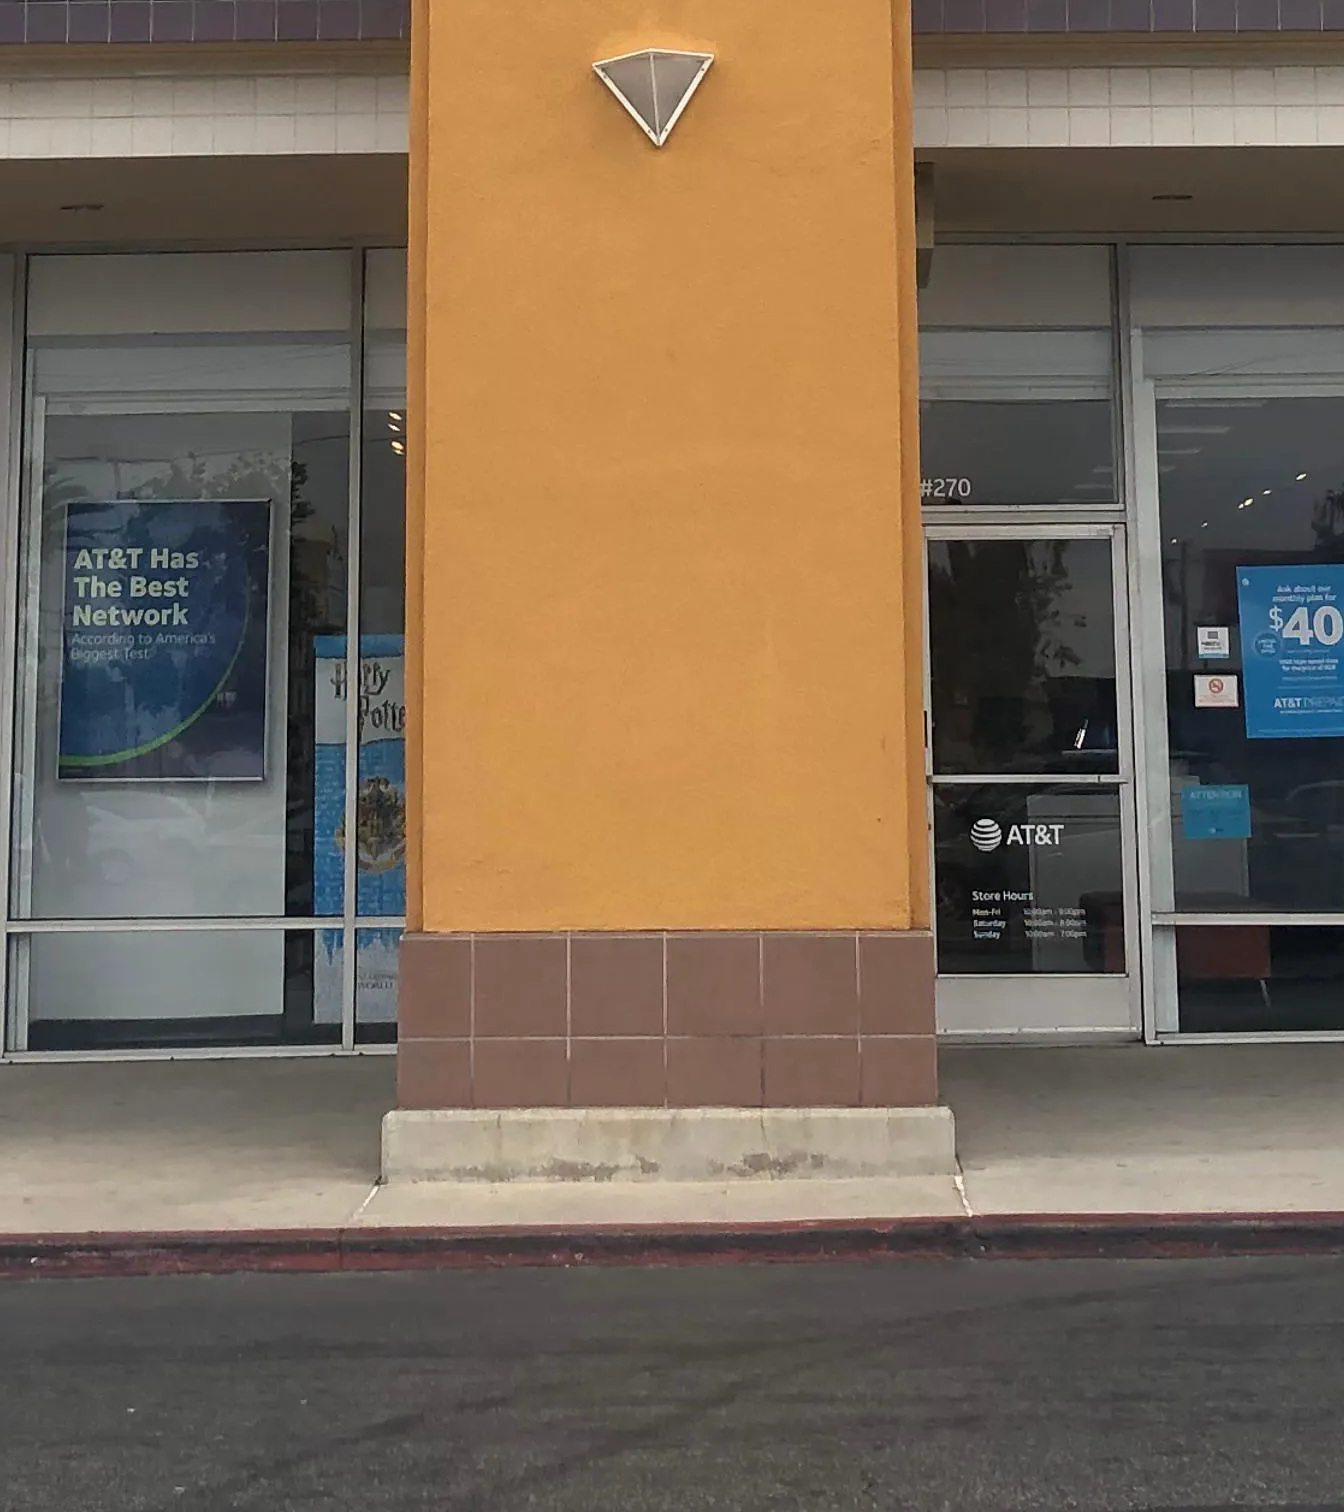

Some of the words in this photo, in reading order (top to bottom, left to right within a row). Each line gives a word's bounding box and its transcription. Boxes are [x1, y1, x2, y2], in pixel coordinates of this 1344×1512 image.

[920, 478, 971, 497] #270
[74, 548, 143, 570] AT&T
[150, 548, 200, 570] Has
[73, 576, 122, 598] The
[130, 576, 189, 598] Best
[73, 603, 189, 626] Network
[1268, 605, 1344, 646] $40
[71, 632, 135, 649] According
[138, 633, 153, 645] to
[1274, 697, 1302, 709] AT&T
[1006, 824, 1065, 845] AT&T
[972, 890, 1001, 901] Store
[1003, 890, 1034, 901] Hours
